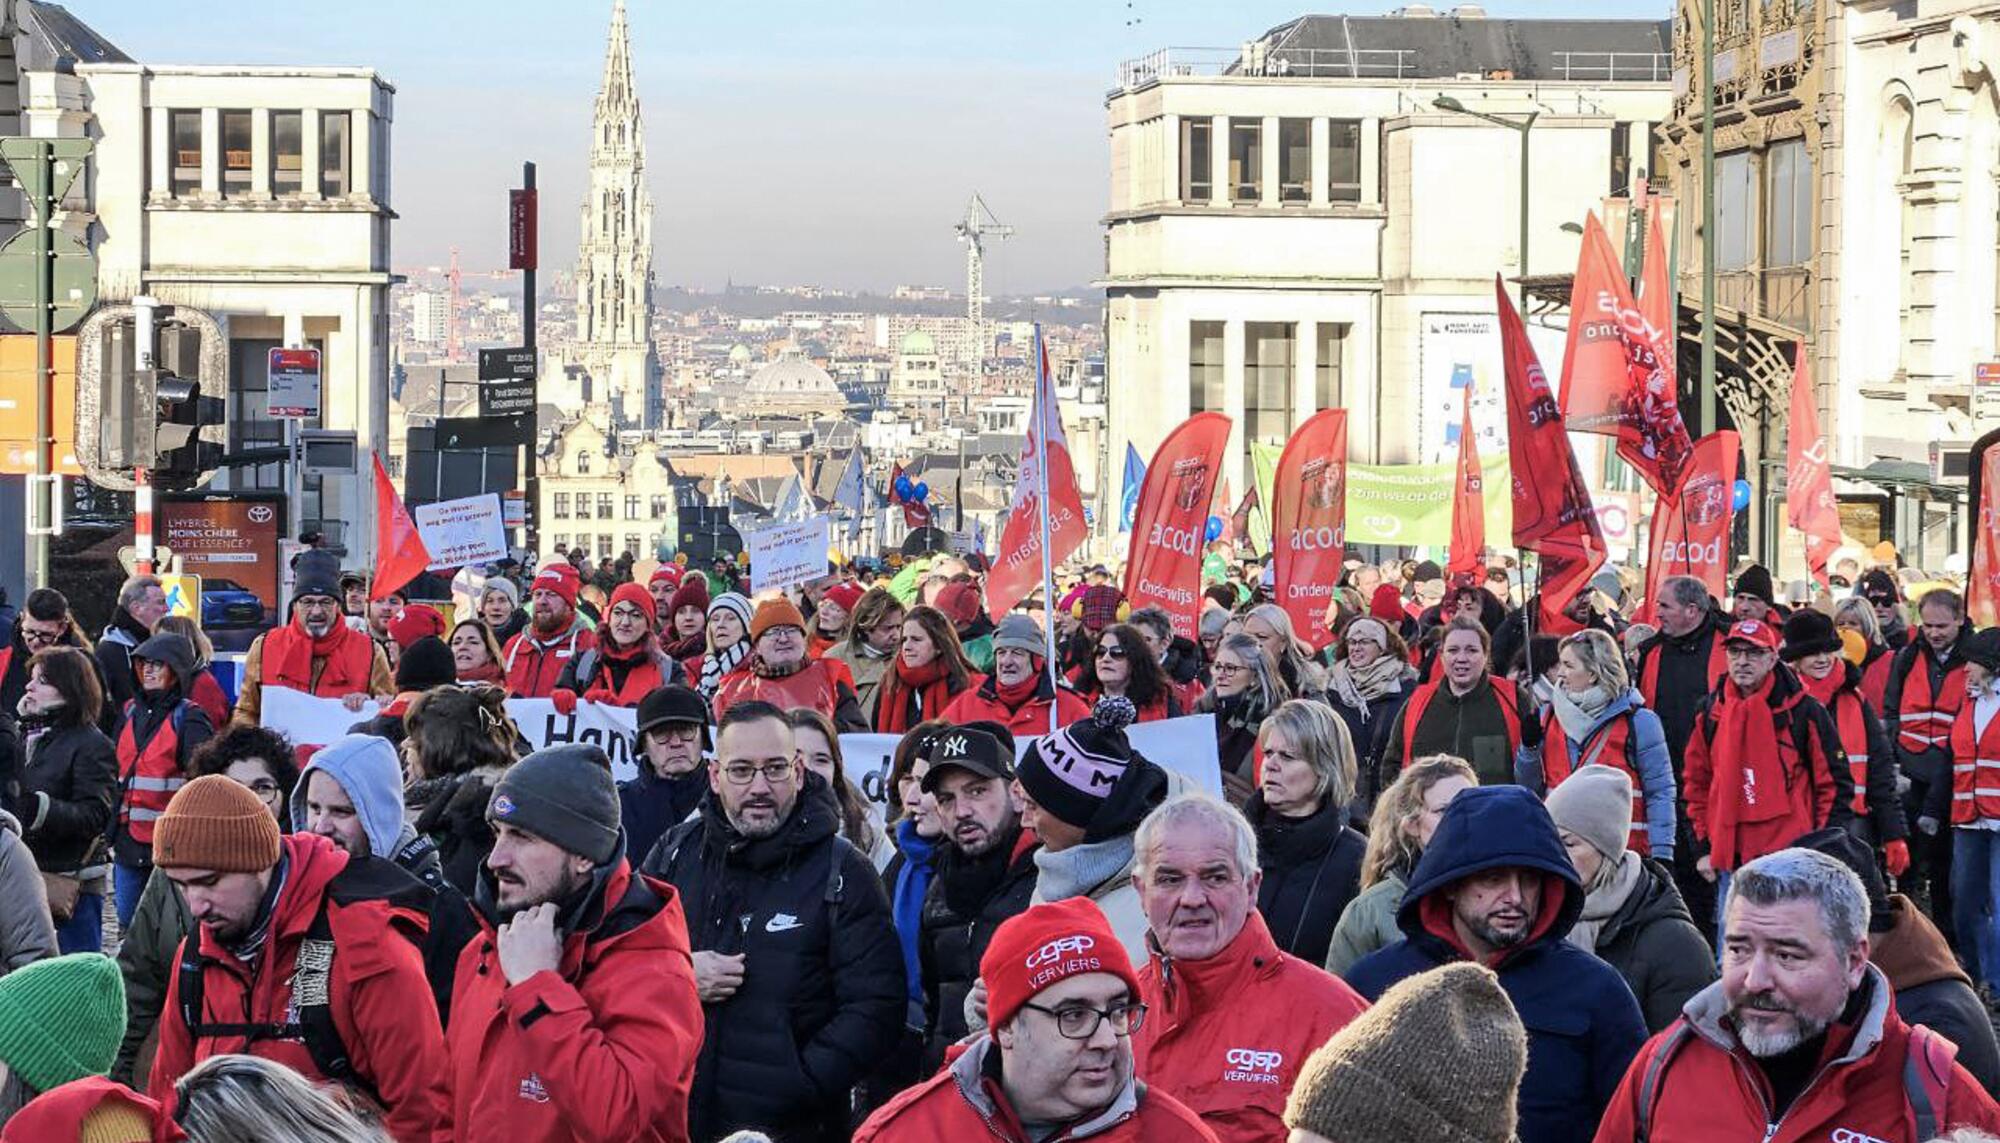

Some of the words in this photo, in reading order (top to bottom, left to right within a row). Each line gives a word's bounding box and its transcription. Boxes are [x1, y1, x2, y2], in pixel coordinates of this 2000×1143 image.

[168, 529, 204, 538] MOINS
[204, 527, 238, 538] CHÈRE
[168, 538, 191, 549] QUE
[1149, 522, 1198, 557] acod
[1291, 519, 1345, 551] acod
[1662, 536, 1721, 566] acod
[1140, 578, 1193, 605] Onderwijs
[1026, 934, 1095, 968] cgsp
[1028, 957, 1101, 990] VERVIERS
[1226, 1047, 1283, 1073] cgsp
[1224, 1069, 1280, 1085] VERVIERS
